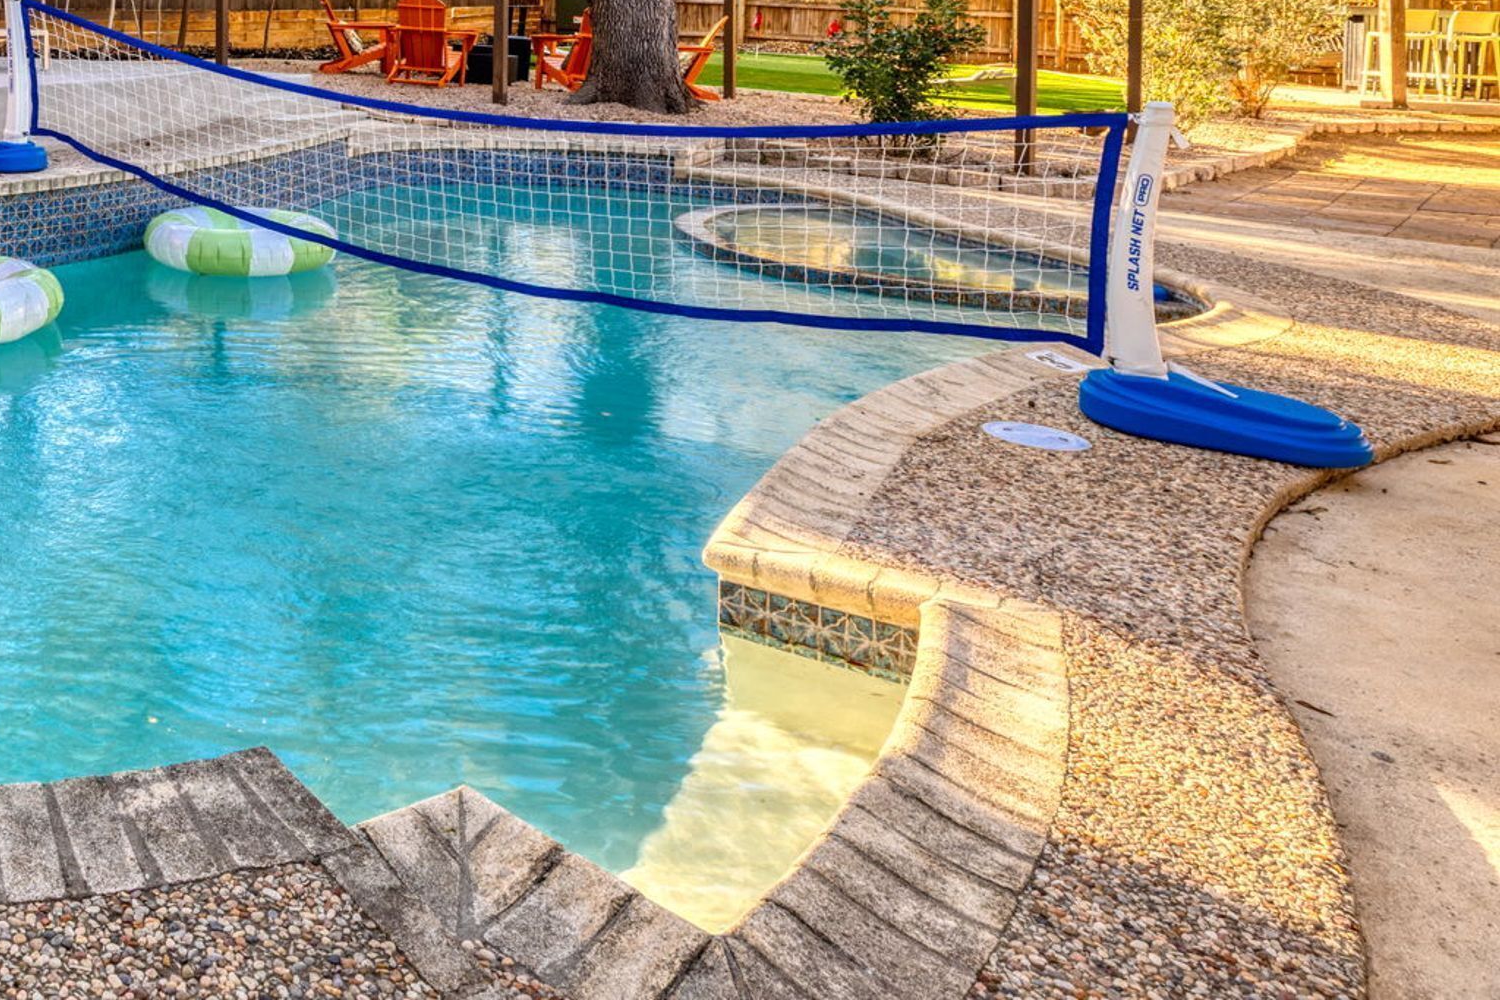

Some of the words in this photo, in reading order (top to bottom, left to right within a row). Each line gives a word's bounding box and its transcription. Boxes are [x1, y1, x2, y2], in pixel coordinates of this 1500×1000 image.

[1137, 177, 1150, 202] PRO
[1131, 208, 1145, 236] NET
[1127, 238, 1142, 291] SPLASH
